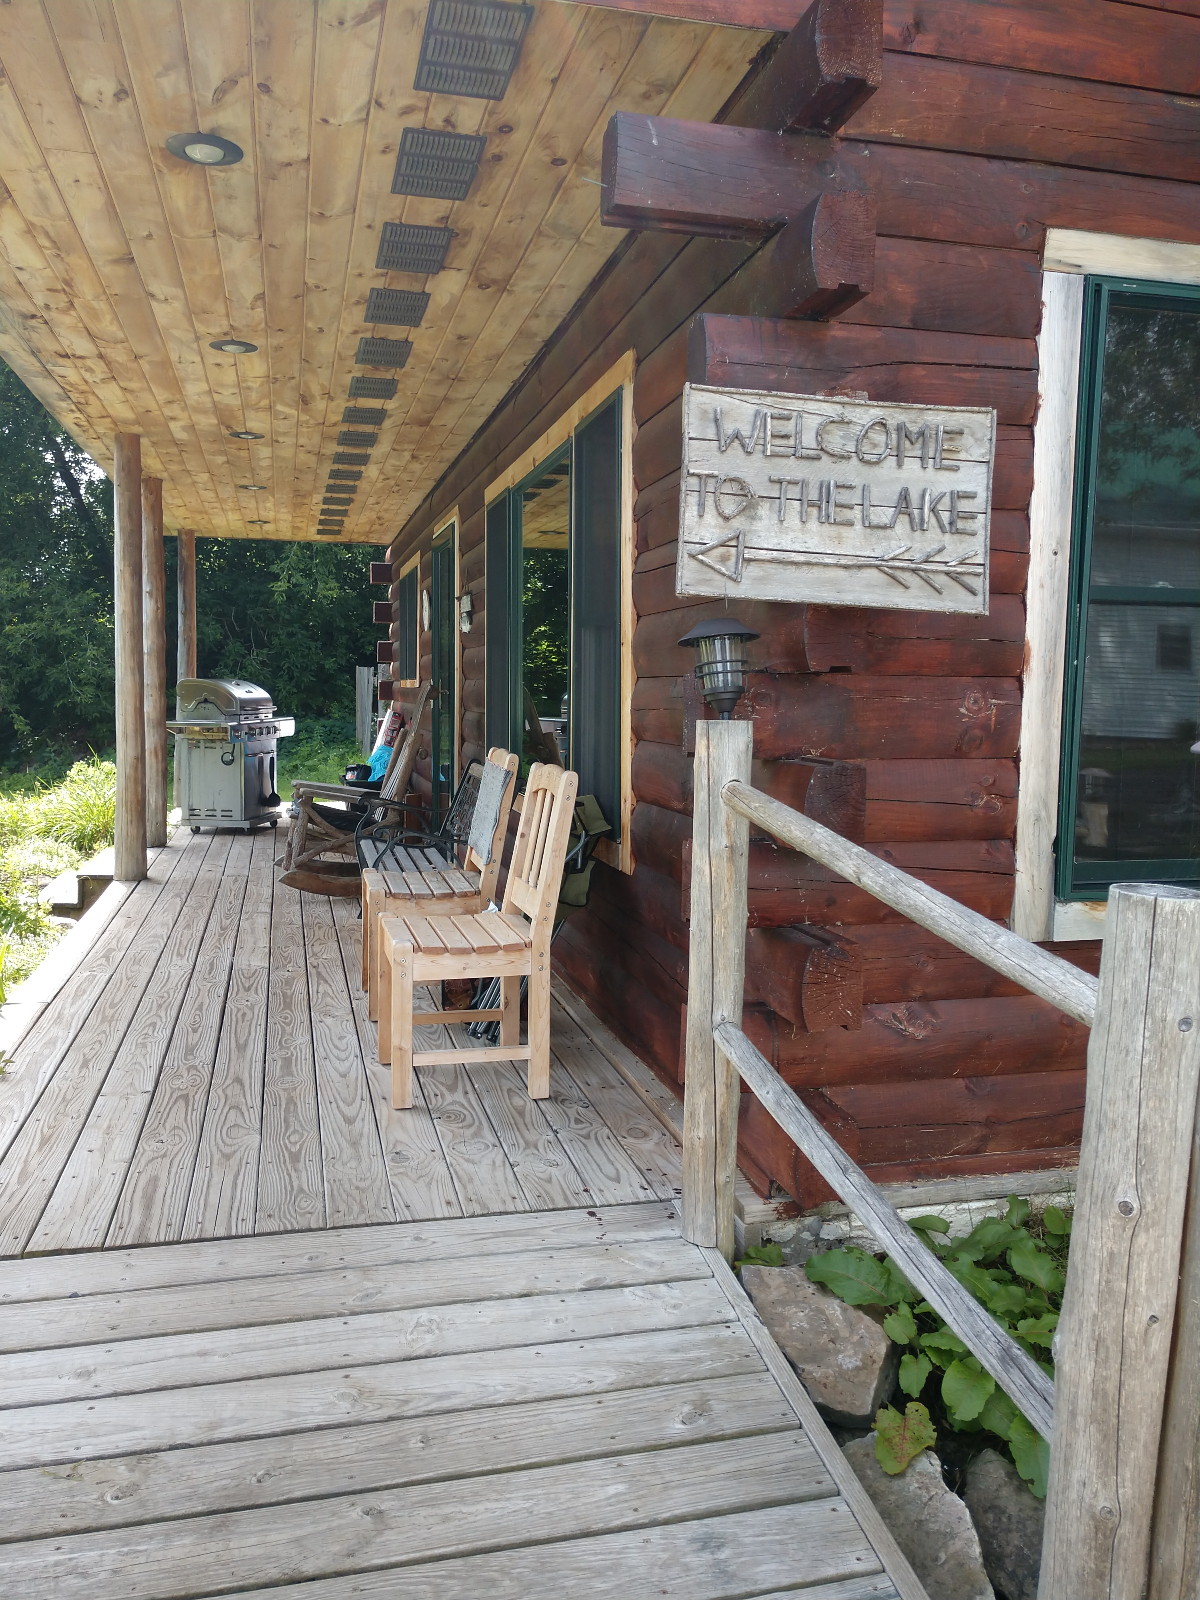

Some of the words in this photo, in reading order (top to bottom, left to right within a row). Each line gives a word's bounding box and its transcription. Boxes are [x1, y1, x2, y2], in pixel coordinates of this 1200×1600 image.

[714, 406, 964, 471] WELCOME
[688, 469, 758, 521] TO
[769, 475, 856, 526] THE
[862, 483, 978, 536] LAKE
